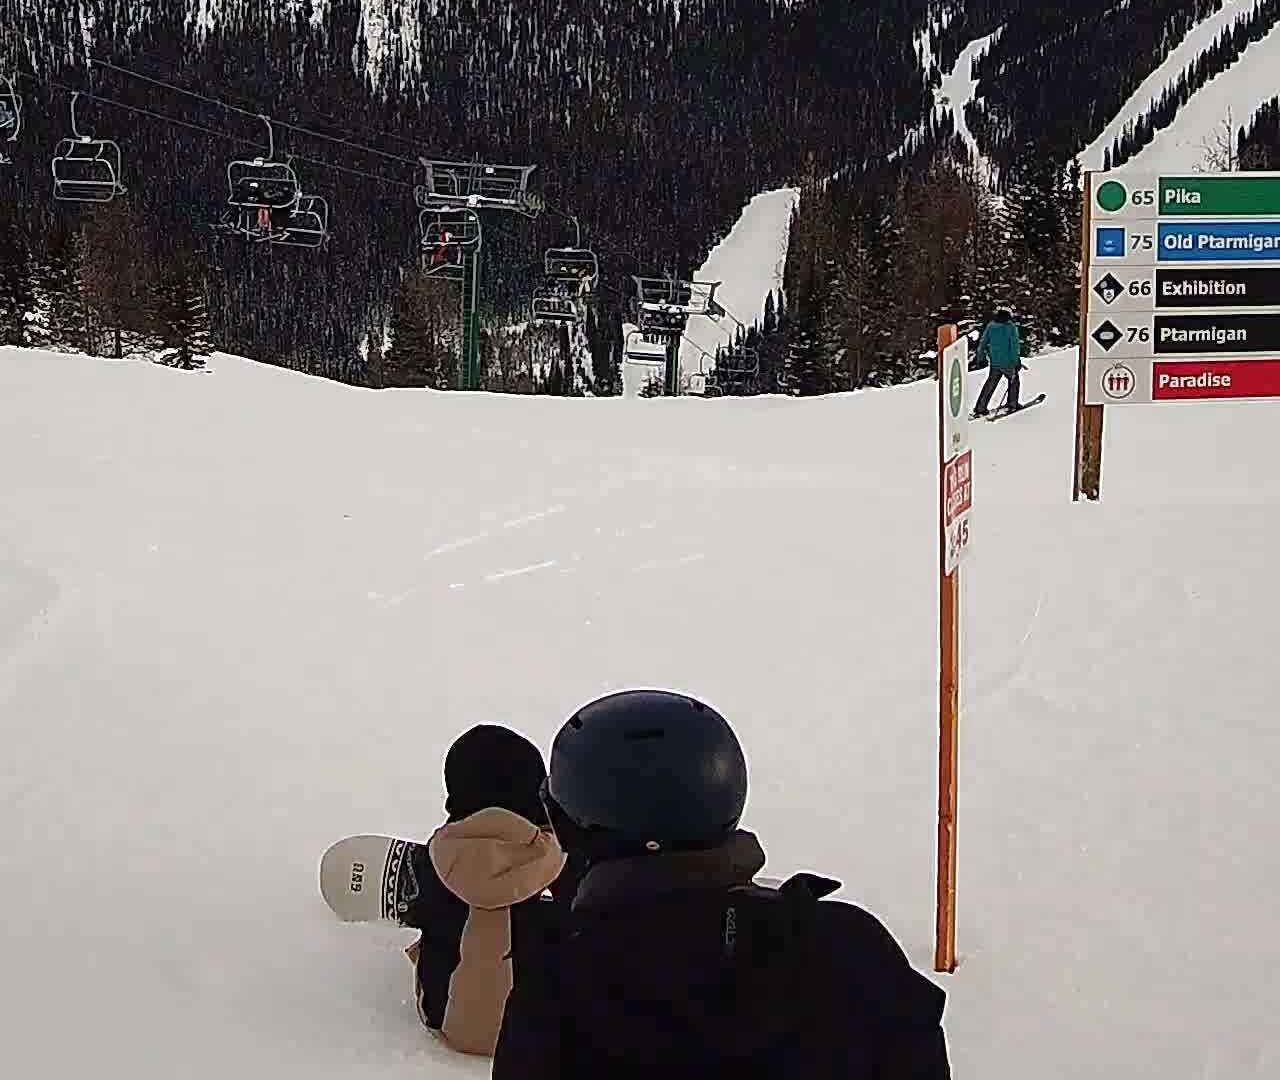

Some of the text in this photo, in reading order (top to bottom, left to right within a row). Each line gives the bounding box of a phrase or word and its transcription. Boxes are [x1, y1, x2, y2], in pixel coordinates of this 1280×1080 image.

[1131, 188, 1201, 206] 65 Pika
[1130, 235, 1153, 250] 75
[1163, 234, 1193, 249] Old
[1128, 279, 1247, 296] 66 Exhibition
[1127, 325, 1247, 345] 76 Ptarmigan
[1159, 372, 1231, 388] Paradise
